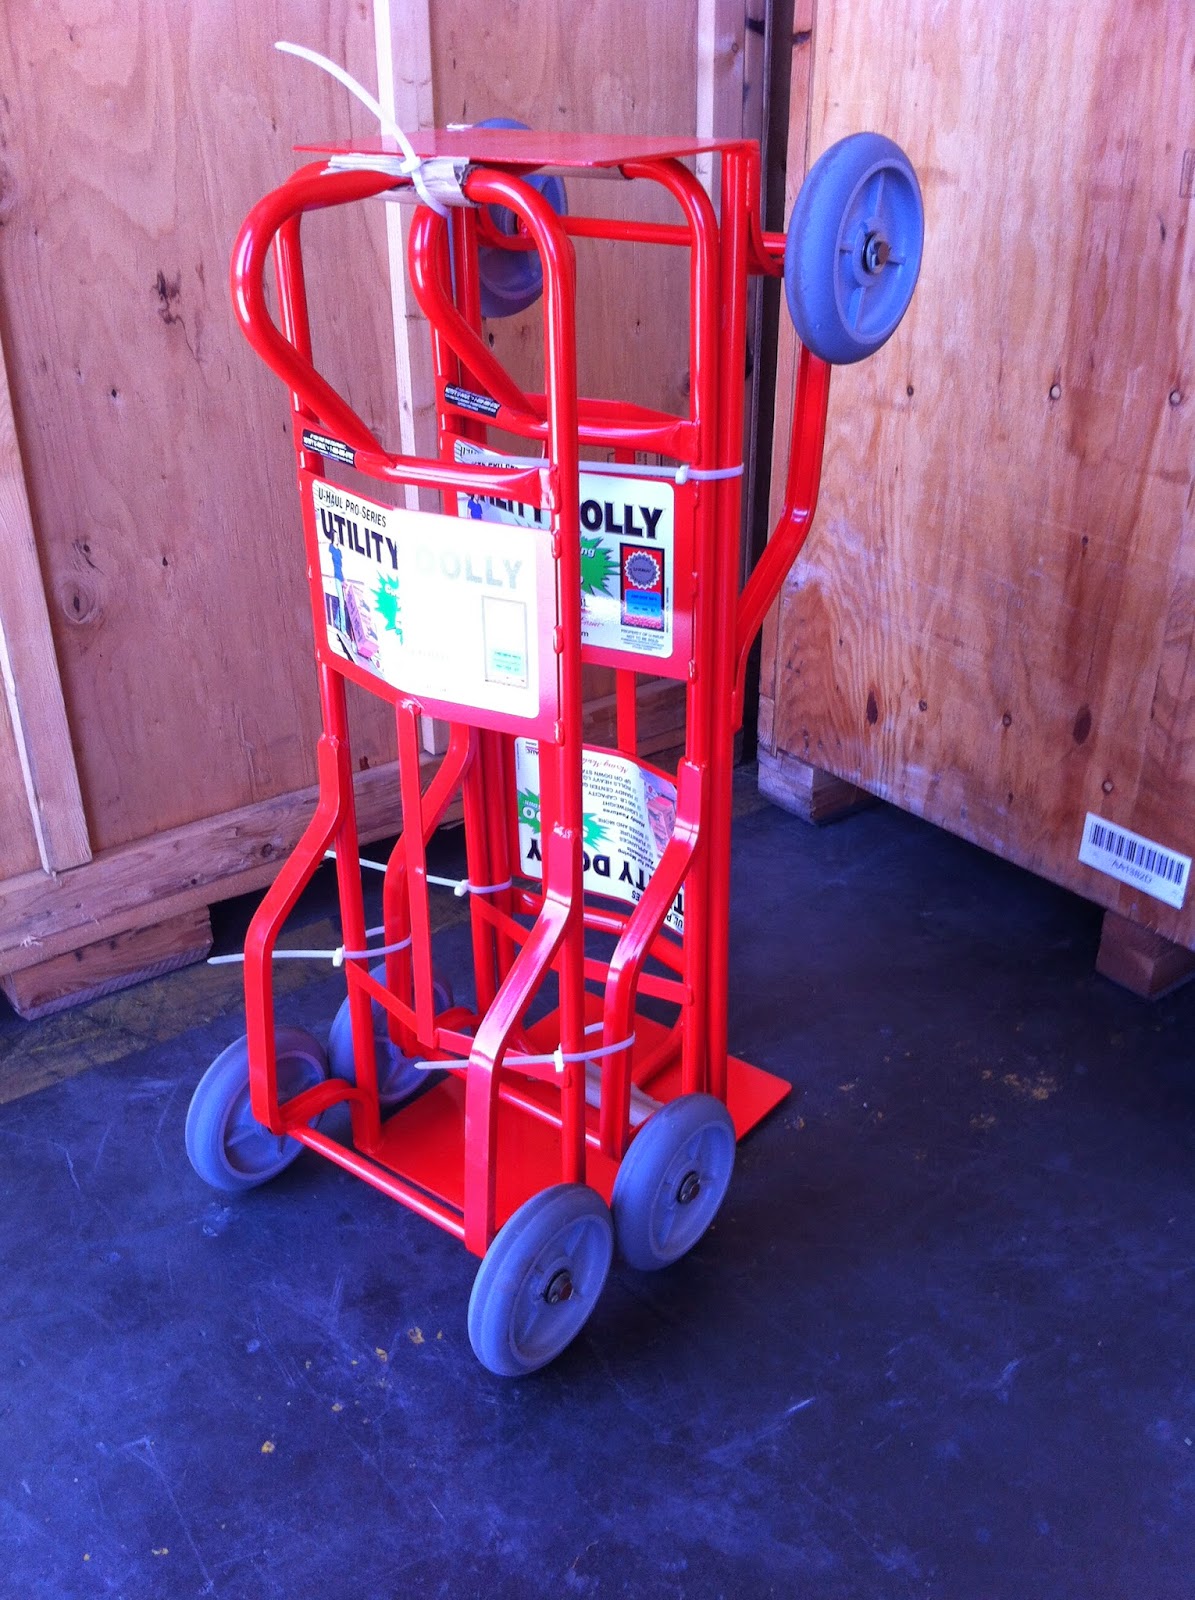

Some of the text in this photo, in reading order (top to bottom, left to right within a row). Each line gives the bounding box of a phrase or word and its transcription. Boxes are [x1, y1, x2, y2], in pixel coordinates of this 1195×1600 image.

[318, 487, 387, 528] U-HAUL PRO SERIES
[580, 499, 664, 539] OLLY
[320, 508, 399, 570] UTILITY
[416, 545, 523, 590] DOLLY
[588, 791, 618, 800] CAPACITY
